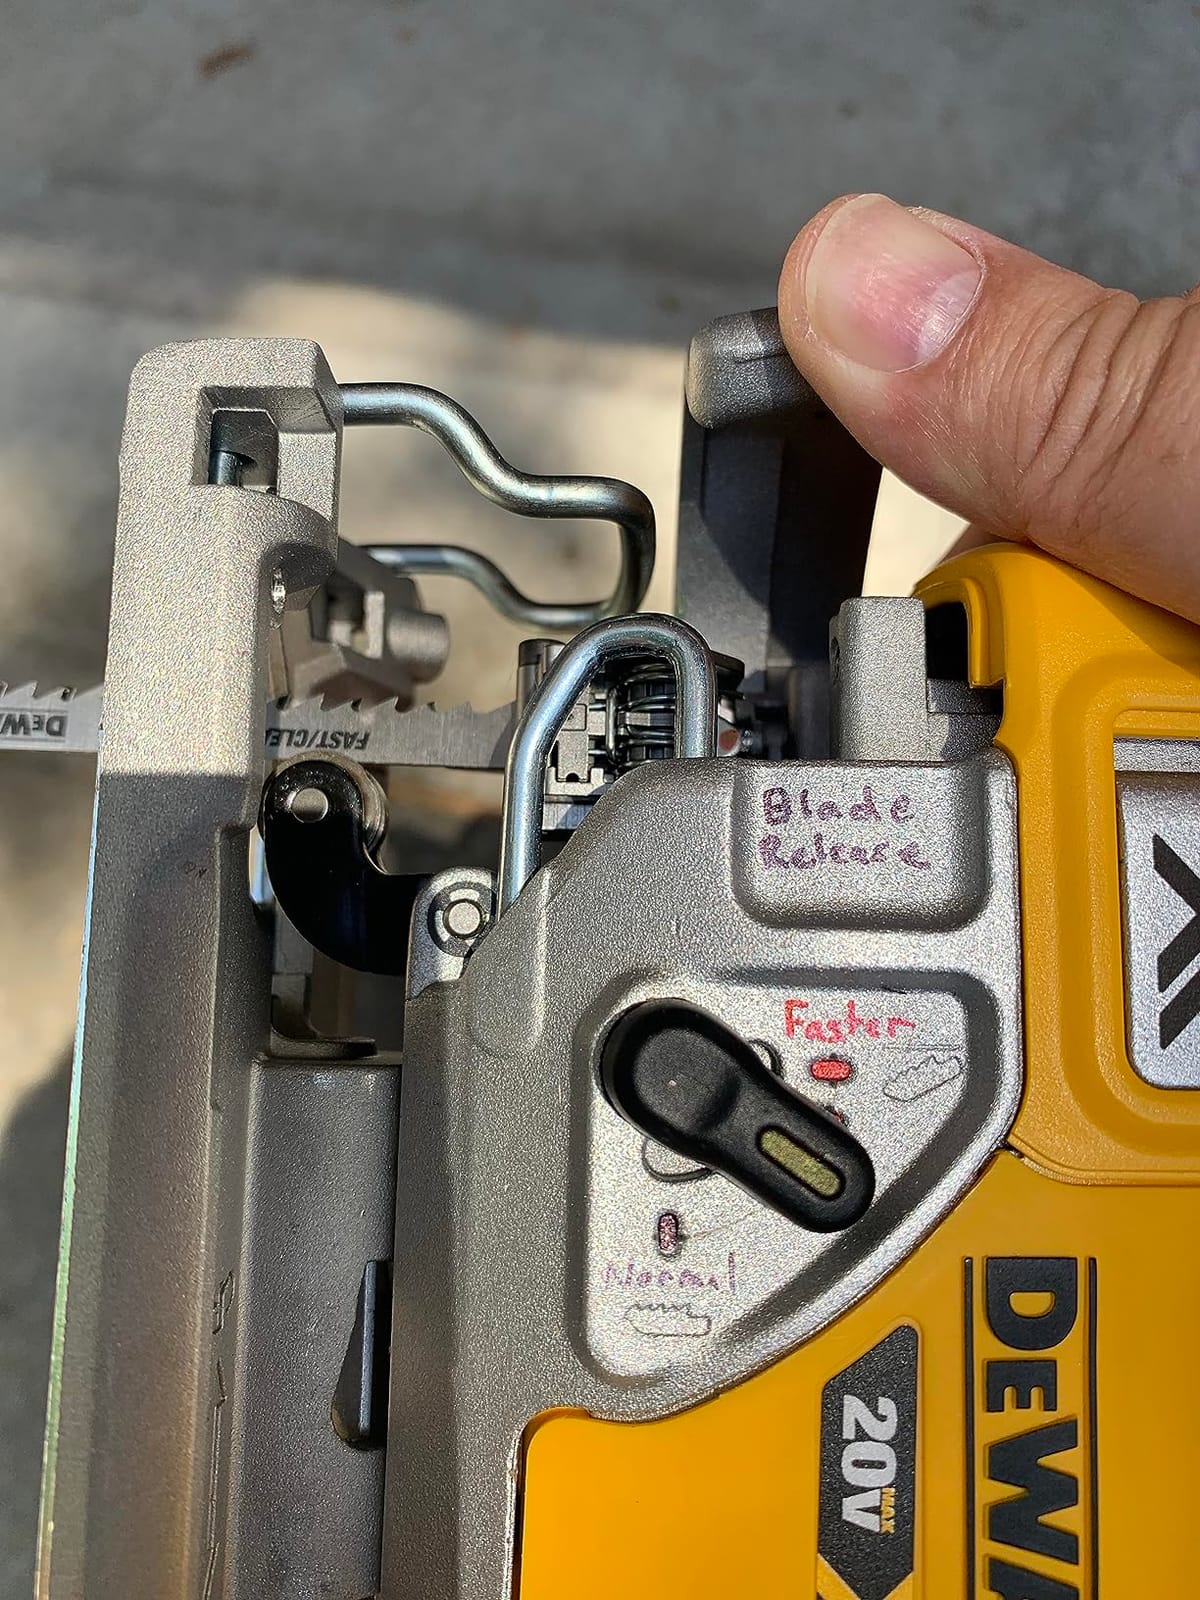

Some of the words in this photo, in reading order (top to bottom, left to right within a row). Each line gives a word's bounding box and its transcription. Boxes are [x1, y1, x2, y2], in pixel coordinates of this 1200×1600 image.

[0, 713, 67, 737] DEW
[762, 784, 916, 827] Blade
[757, 832, 933, 871] Release
[784, 999, 917, 1044] Faster
[601, 1251, 736, 1293] Normal
[841, 1394, 898, 1534] 20V
[881, 1487, 896, 1534] MAX
